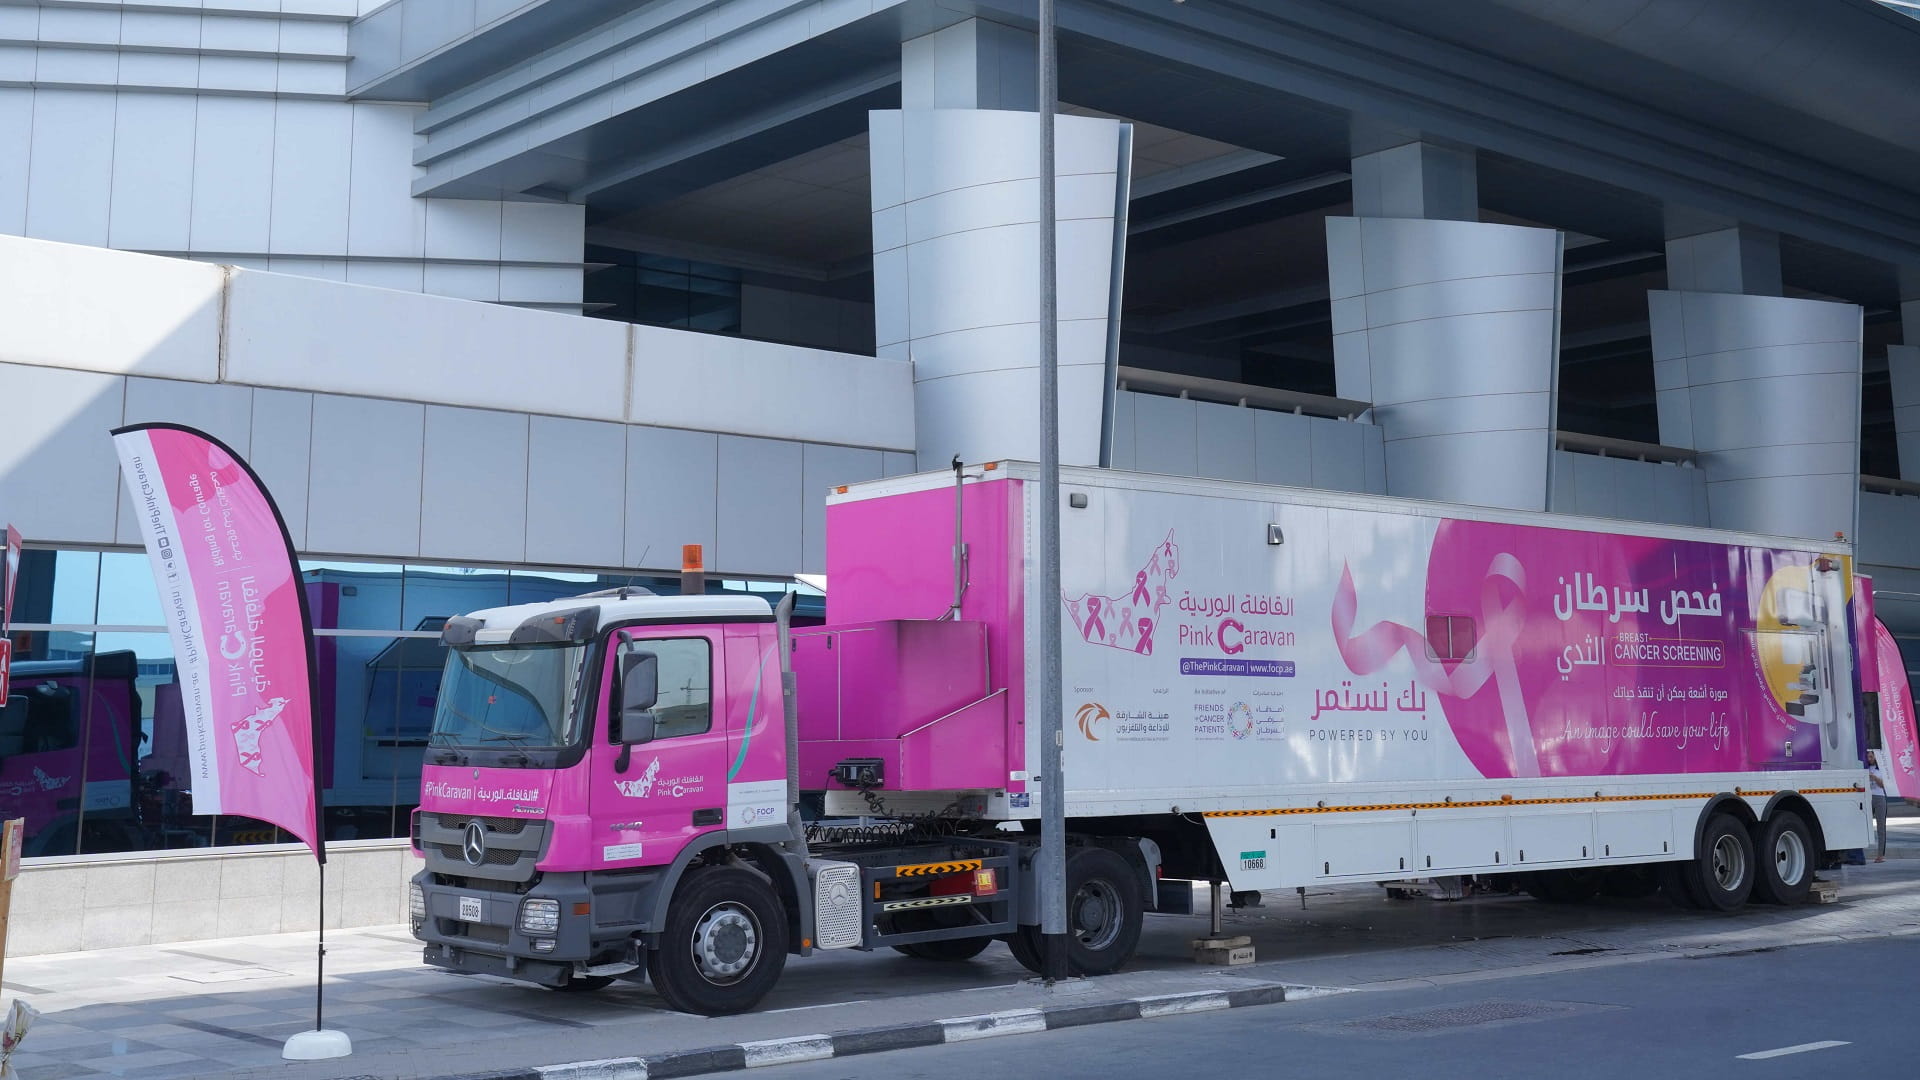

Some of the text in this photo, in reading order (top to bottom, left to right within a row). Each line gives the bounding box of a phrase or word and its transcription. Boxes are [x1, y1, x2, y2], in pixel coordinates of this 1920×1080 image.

[1179, 590, 1294, 618] القافلة الوردية
[1554, 572, 1722, 625] فحص سرطان
[1179, 618, 1295, 655] Pink Caravan
[1619, 632, 1649, 643] BREAST
[1557, 633, 1606, 681] الثدي
[1614, 644, 1722, 662] CANCER SCREENING
[1182, 661, 1293, 676] @ThePinkCaravan www.focp.ae
[1613, 685, 1635, 701] حياتك
[1656, 684, 1665, 702] أن
[1667, 686, 1686, 702] يمكن
[1688, 684, 1707, 699] أشعة
[1709, 689, 1728, 702] صورة
[1194, 704, 1225, 712] FRIENDS
[1310, 680, 1426, 721] بك نستمر
[1200, 715, 1225, 723] CANCER
[1194, 725, 1225, 733] PATIENTS
[1310, 729, 1428, 741] POWERED BY YOU
[1561, 711, 1730, 753] An image could save your life
[425, 782, 471, 800] #PinkCaravan
[657, 785, 704, 798] Pink Caravan
